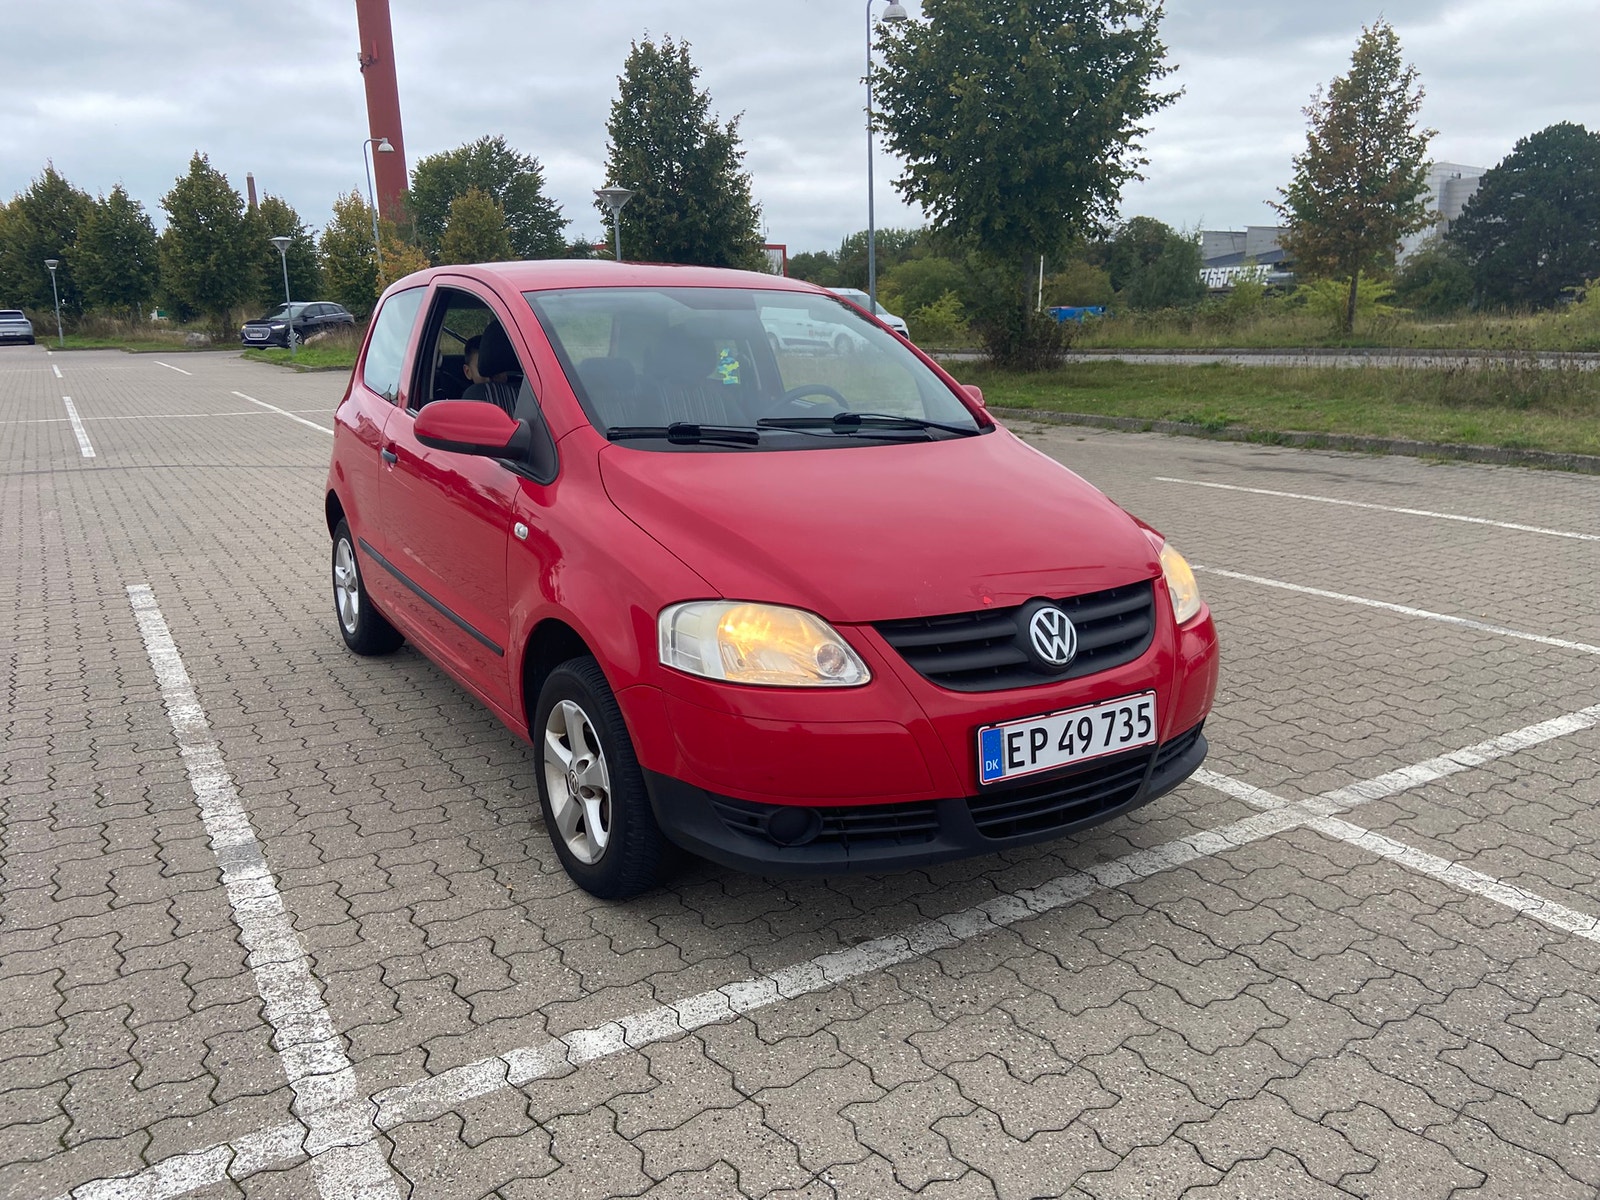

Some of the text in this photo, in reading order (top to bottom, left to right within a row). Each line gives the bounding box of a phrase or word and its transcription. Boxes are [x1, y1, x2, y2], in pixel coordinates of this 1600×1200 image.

[1031, 608, 1076, 664] VW
[1007, 702, 1151, 769] EP 49 735
[985, 758, 999, 772] DK
